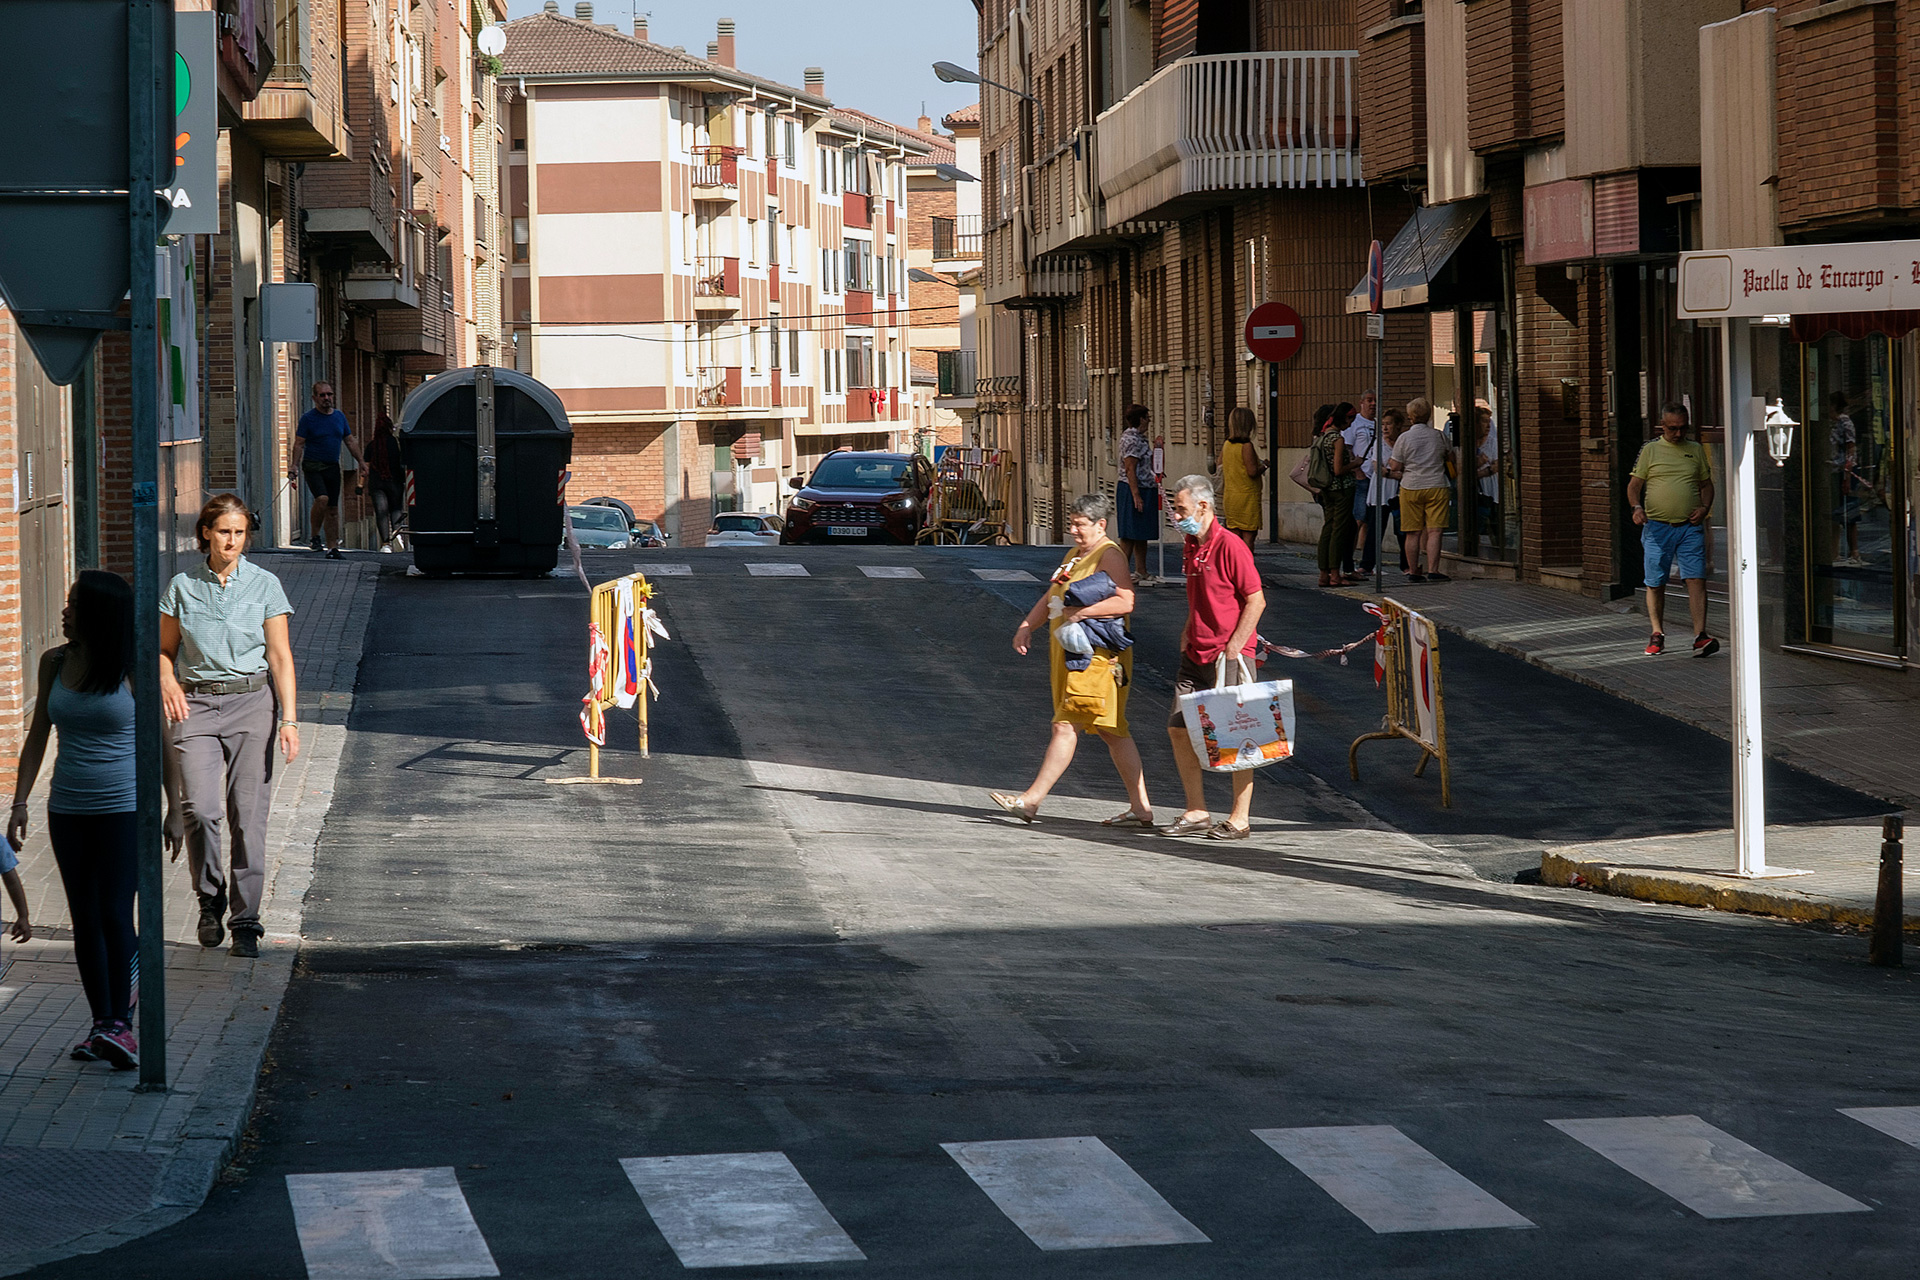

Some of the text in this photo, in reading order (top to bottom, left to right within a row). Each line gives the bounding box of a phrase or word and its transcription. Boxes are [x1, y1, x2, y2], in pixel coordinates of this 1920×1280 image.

[1743, 268, 1788, 298] Paella
[1797, 266, 1812, 289] de
[1820, 264, 1884, 292] Encargo
